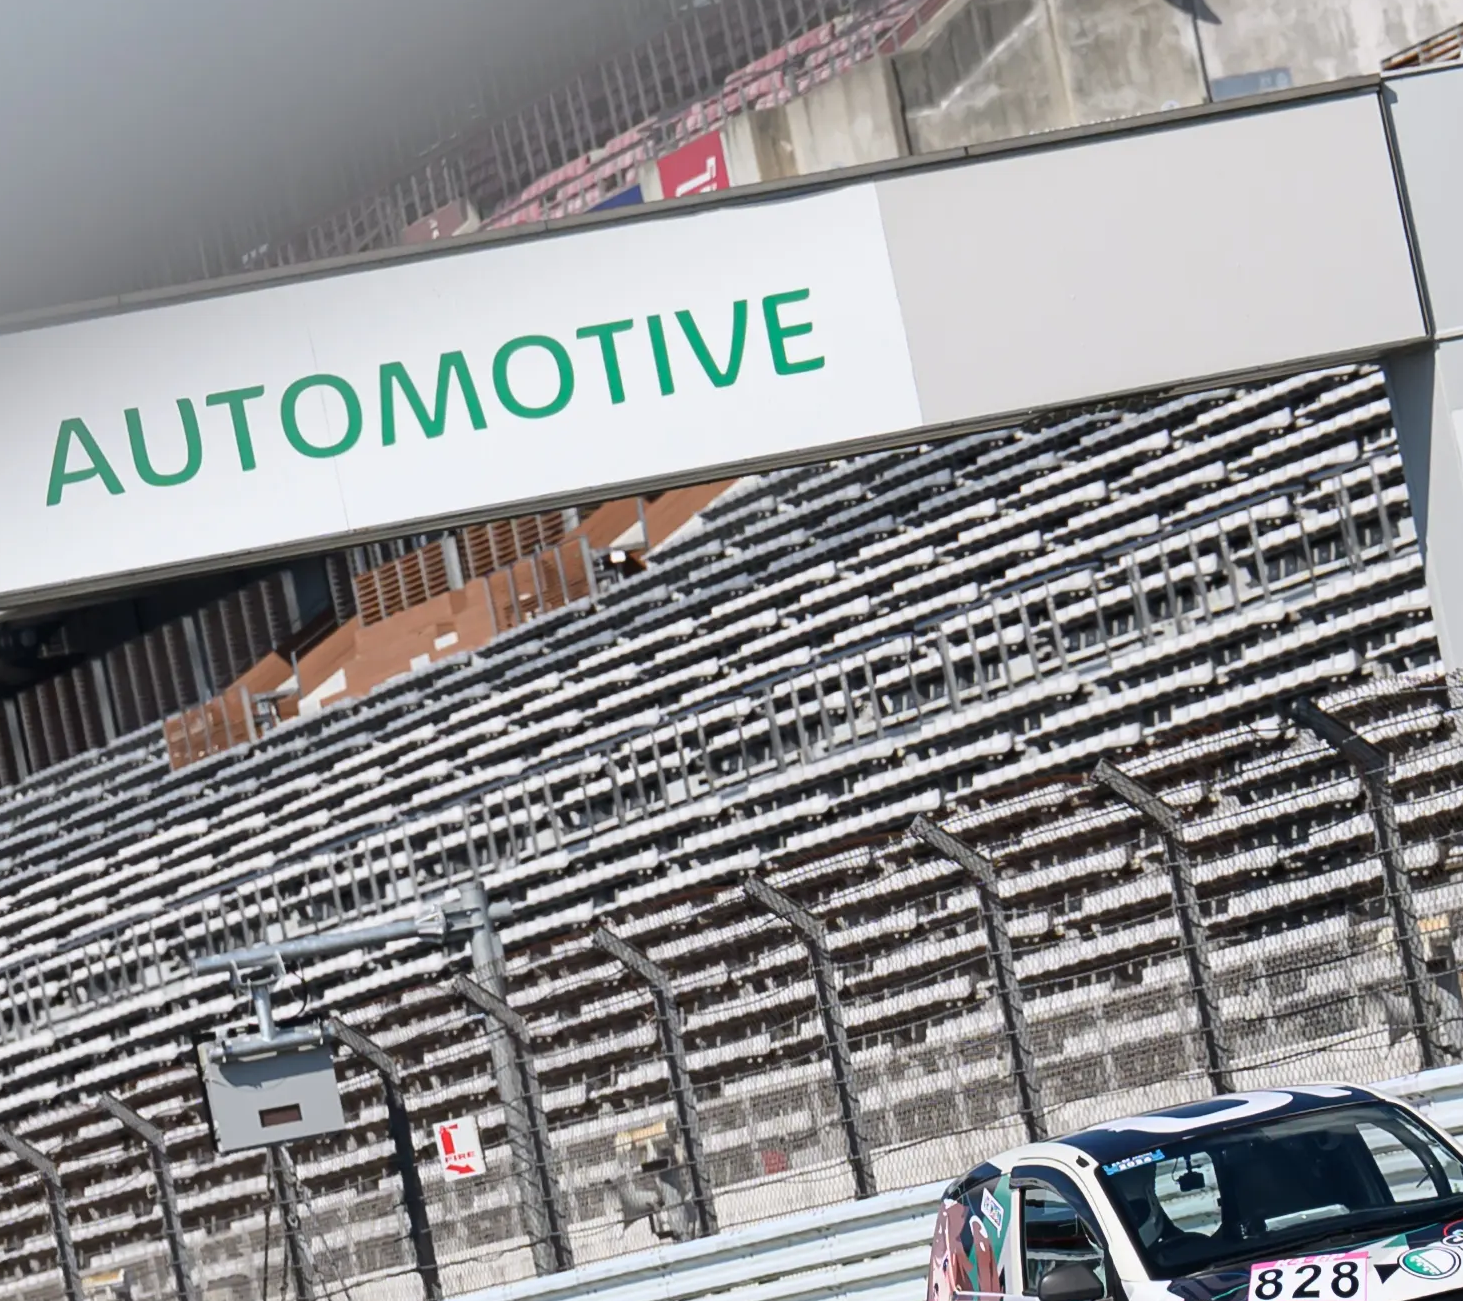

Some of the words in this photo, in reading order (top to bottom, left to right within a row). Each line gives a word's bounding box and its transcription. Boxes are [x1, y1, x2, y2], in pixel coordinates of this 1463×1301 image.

[46, 287, 826, 507] AUTOMOTIVE
[445, 1150, 475, 1164] FIRE
[1254, 1261, 1360, 1301] 828
